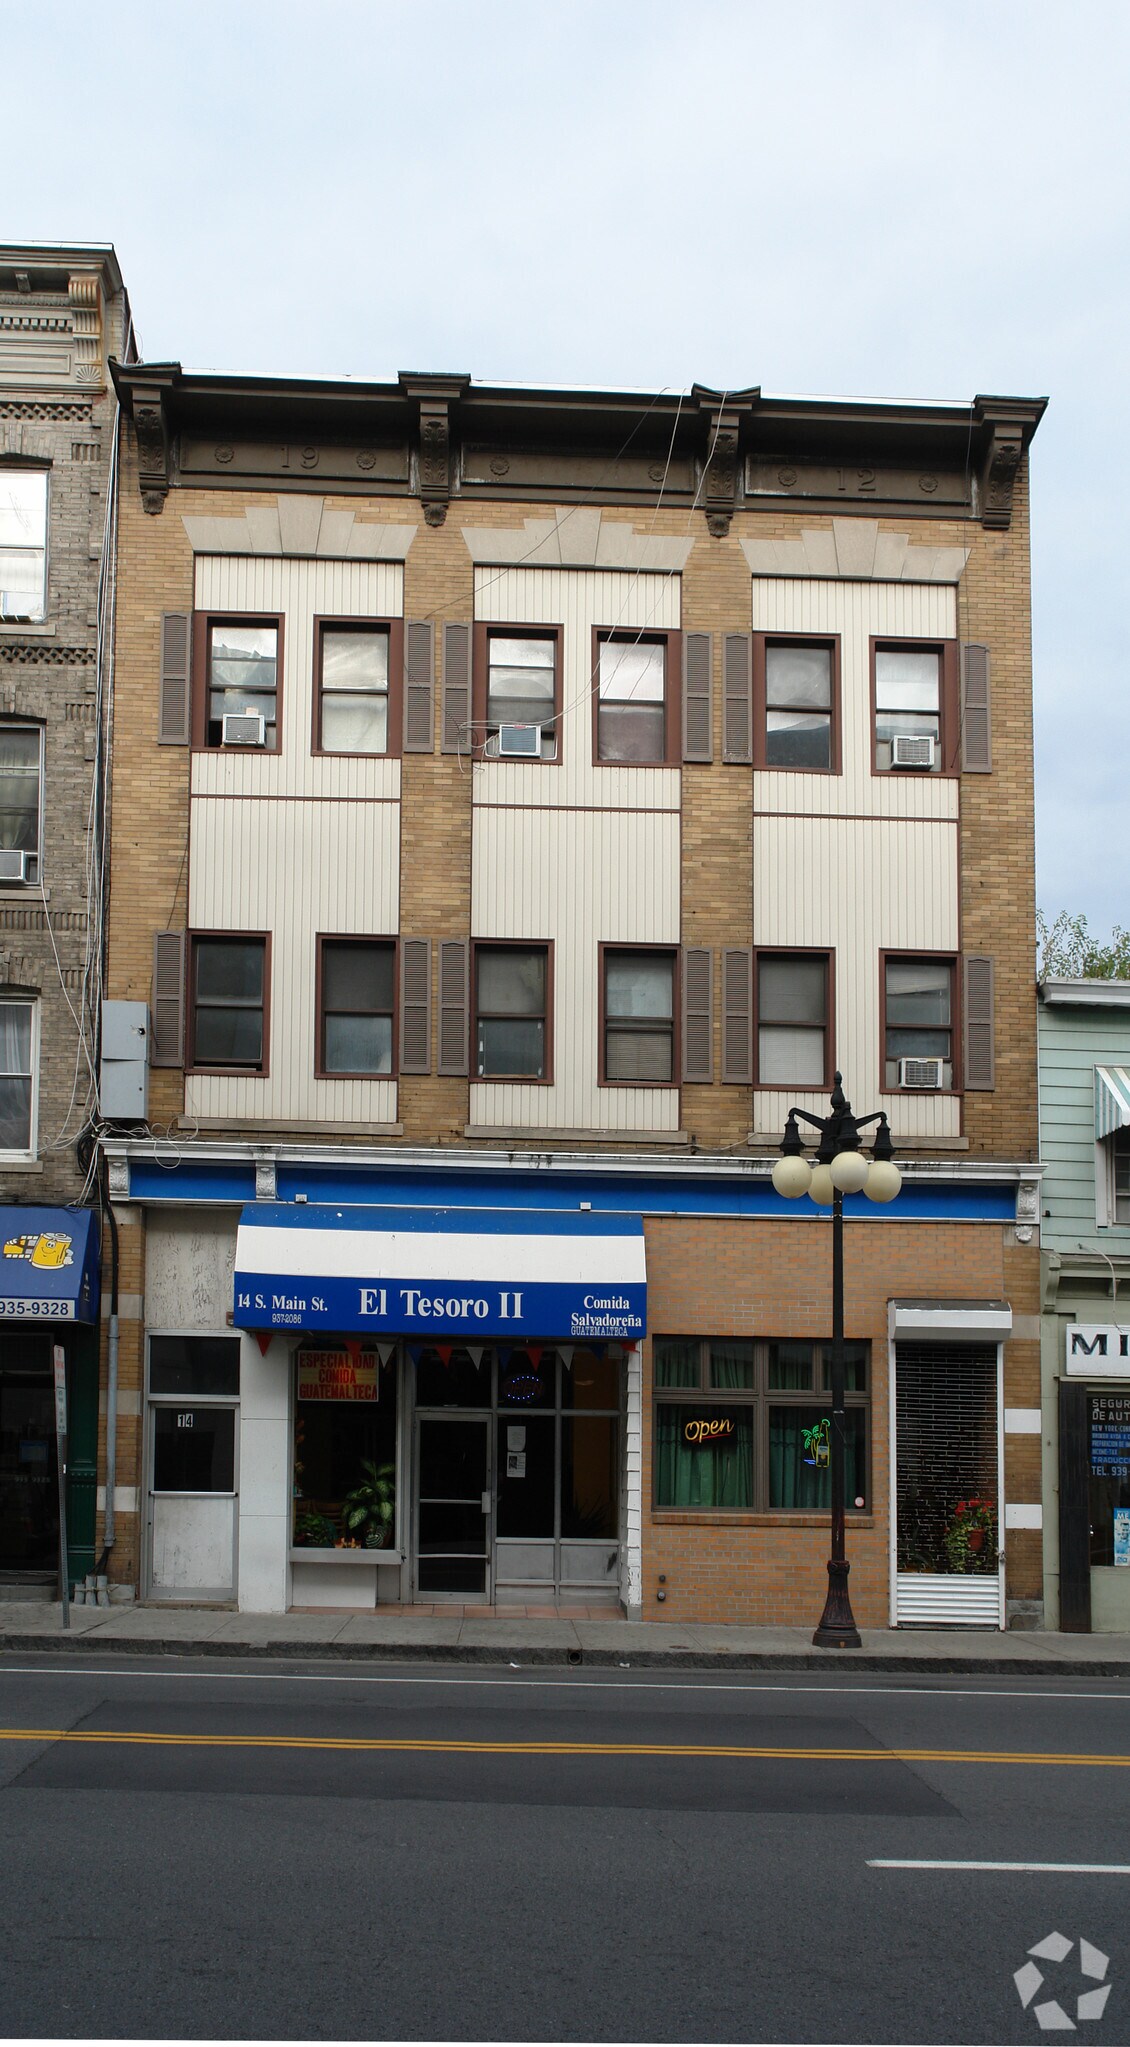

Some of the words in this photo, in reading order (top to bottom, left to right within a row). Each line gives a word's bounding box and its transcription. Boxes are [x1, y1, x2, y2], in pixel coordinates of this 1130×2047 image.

[279, 446, 320, 470] 19
[837, 467, 877, 491] 12
[0, 1301, 69, 1316] 935-9328
[237, 1293, 251, 1308] 14
[254, 1294, 267, 1309] S.
[271, 1295, 307, 1311] Main
[311, 1297, 328, 1312] St.
[358, 1288, 388, 1316] El
[400, 1289, 489, 1319] Tesoro
[498, 1292, 524, 1319] II
[583, 1295, 631, 1310] Comida
[571, 1312, 642, 1327] Salvadoreña
[571, 1325, 629, 1336] GUATEMALTECA
[300, 1352, 376, 1369] ESPECIALIDAD
[318, 1368, 357, 1384] COMIDA
[299, 1383, 377, 1400] GUATEMALTECA
[179, 1414, 193, 1427] 14
[1092, 1410, 1106, 1421] DE
[684, 1417, 735, 1443] Open
[1091, 1466, 1110, 1476] TEL.
